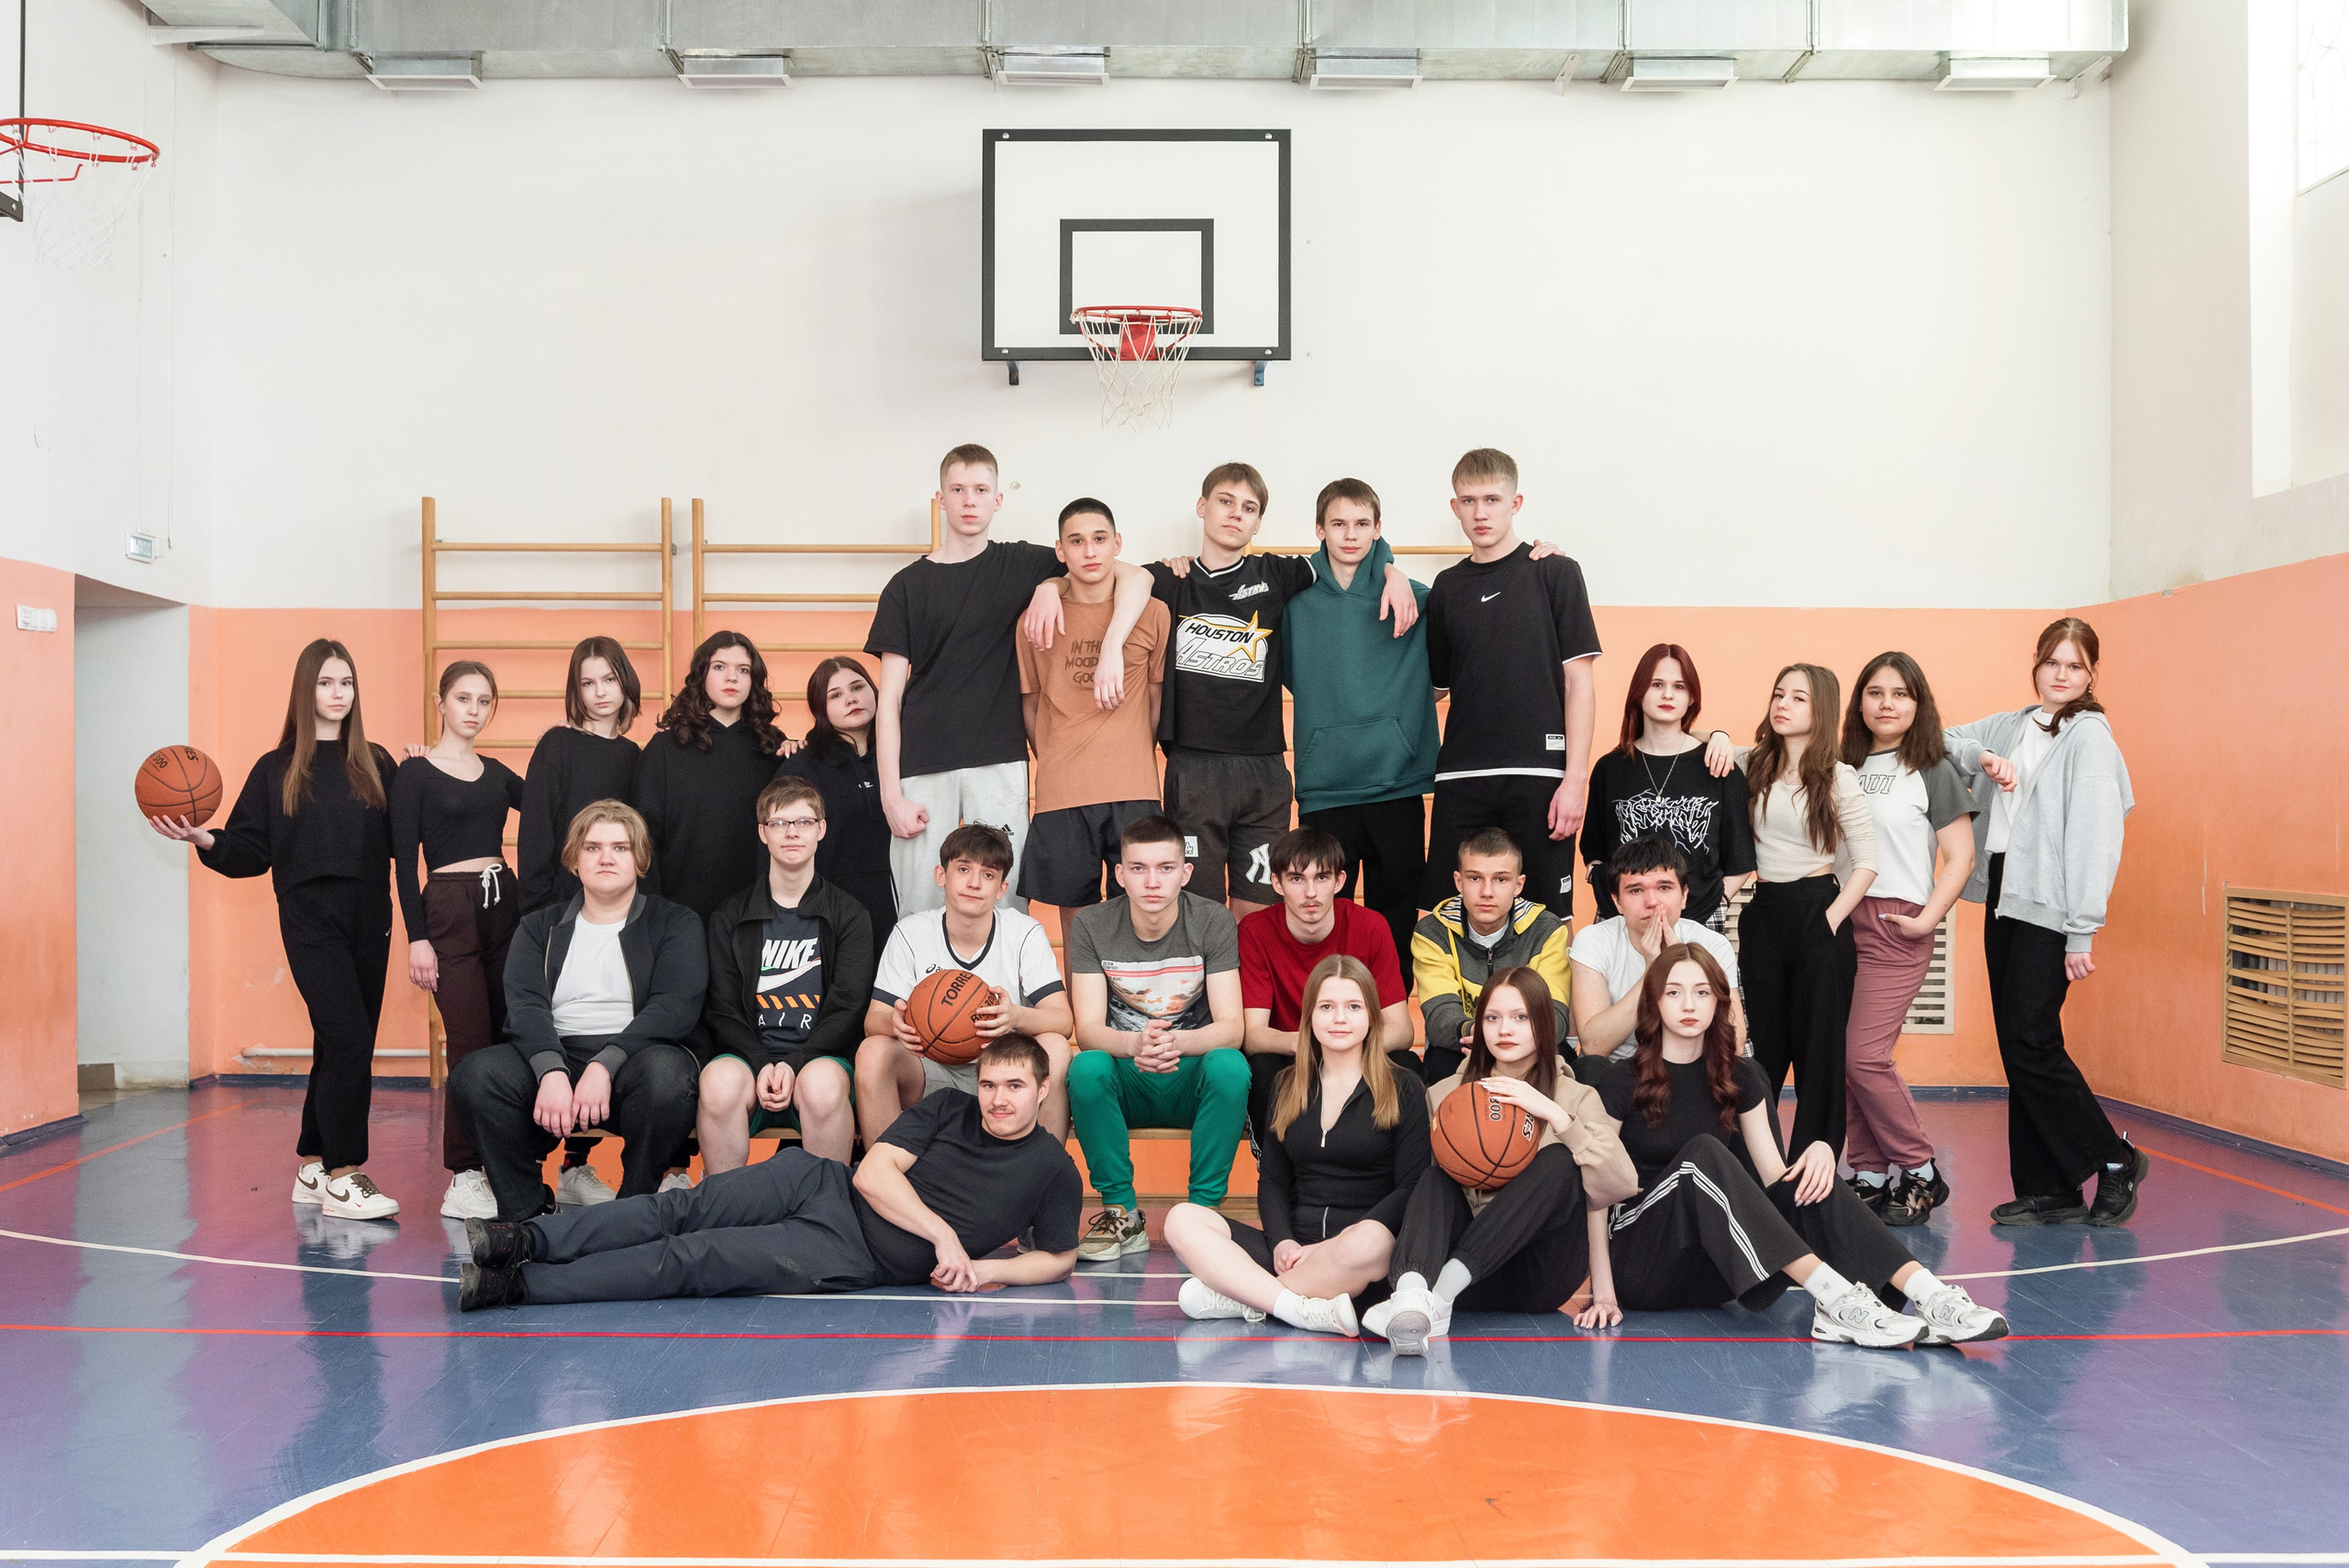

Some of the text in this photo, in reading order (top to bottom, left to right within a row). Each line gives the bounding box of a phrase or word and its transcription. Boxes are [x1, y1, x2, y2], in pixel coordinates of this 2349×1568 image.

[1185, 622, 1255, 644] HOUSTON
[1071, 639, 1102, 654] IN TH
[1065, 655, 1098, 670] MOOD
[1175, 636, 1265, 677] ASTROS
[1857, 773, 1897, 795] AUI
[762, 938, 818, 969] NIKE
[758, 1012, 811, 1029] AIR
[1847, 1307, 1870, 1324] N
[1939, 1304, 1955, 1321] N
